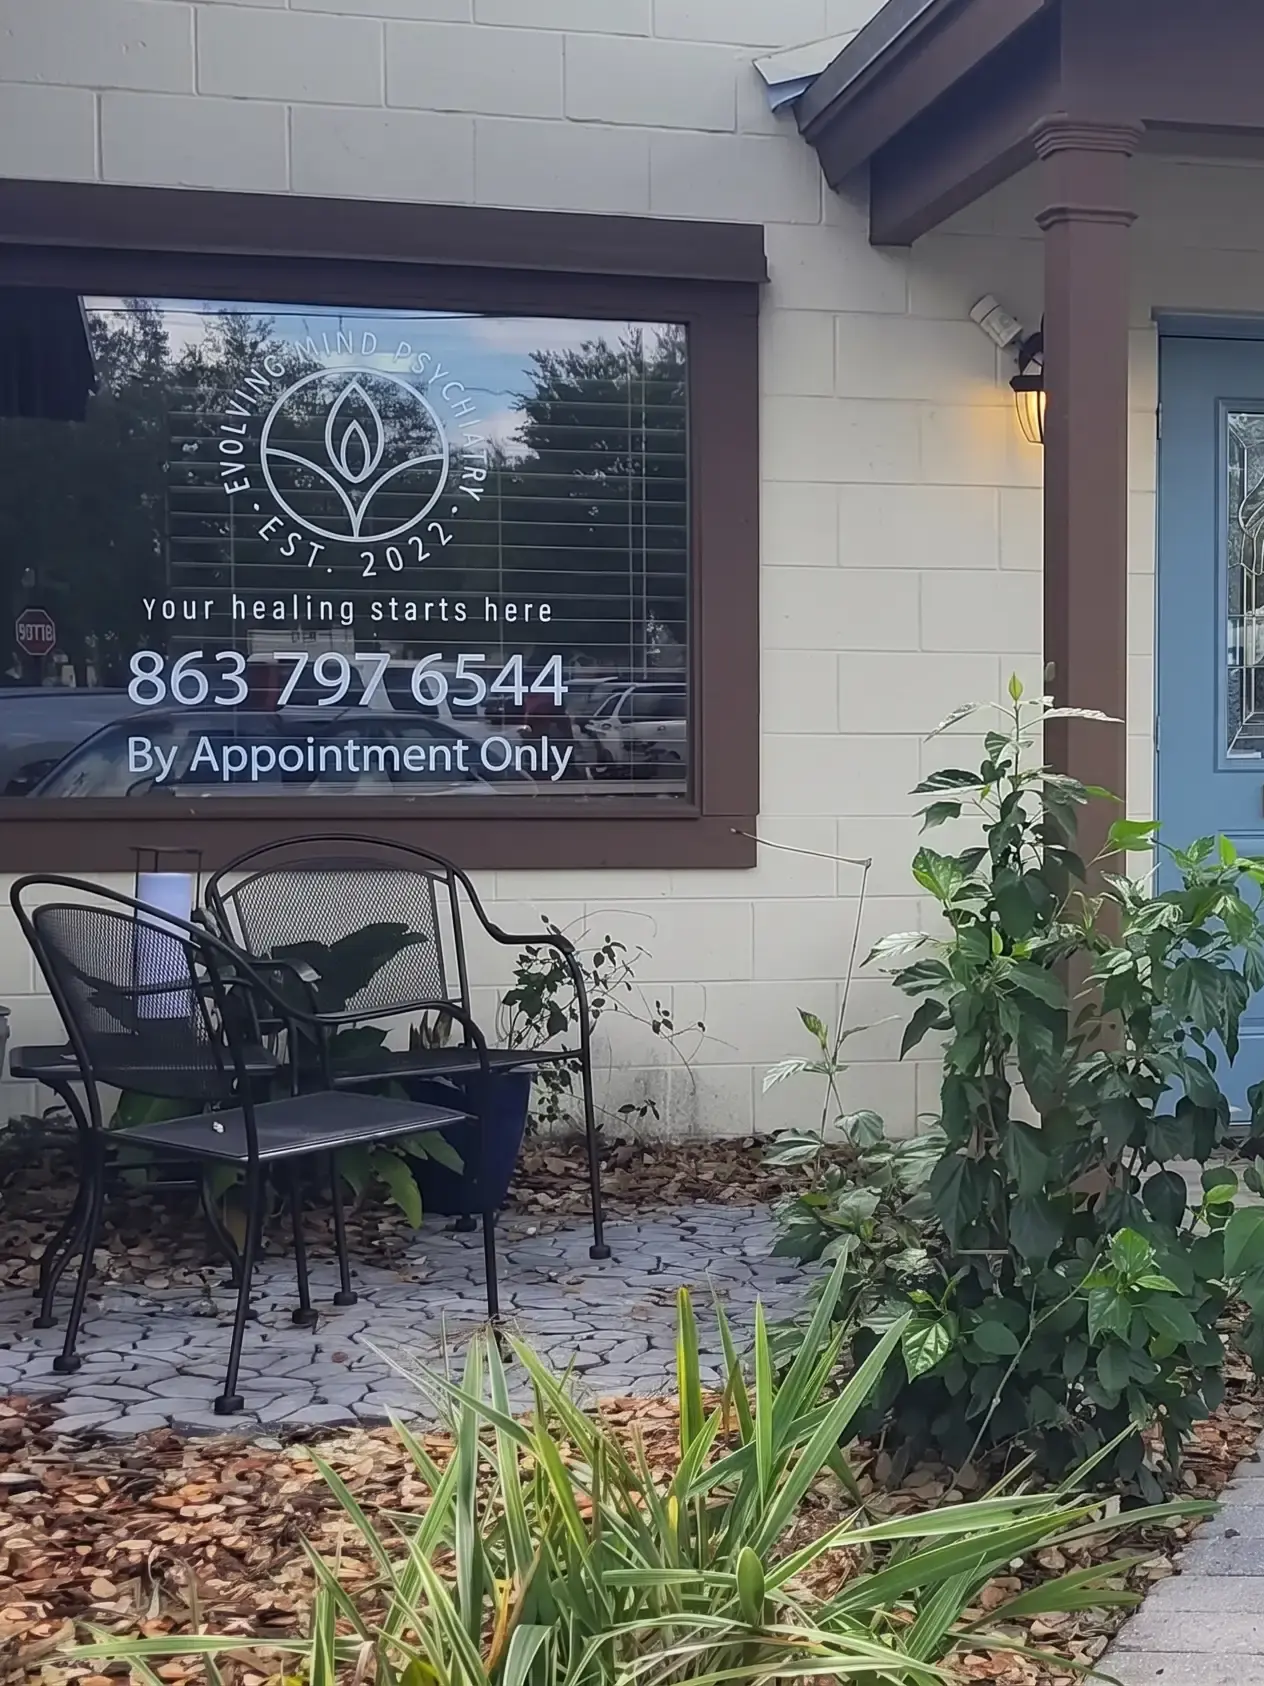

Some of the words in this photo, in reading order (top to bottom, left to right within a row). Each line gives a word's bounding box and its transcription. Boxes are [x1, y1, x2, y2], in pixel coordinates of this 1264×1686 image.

[218, 354, 286, 495] EVOLVING
[294, 331, 377, 358] MIND
[392, 342, 488, 502] PSYCHIATRY
[257, 515, 333, 574] EST.
[360, 521, 453, 578] 2022
[142, 597, 214, 621] Your
[232, 594, 355, 626] healing
[370, 597, 467, 622] starts
[484, 597, 553, 622] here
[127, 650, 249, 707] 863
[273, 651, 391, 707] 797
[410, 652, 569, 707] 6544
[127, 736, 179, 783] By
[189, 736, 470, 782] Appointment
[479, 736, 574, 782] Only
